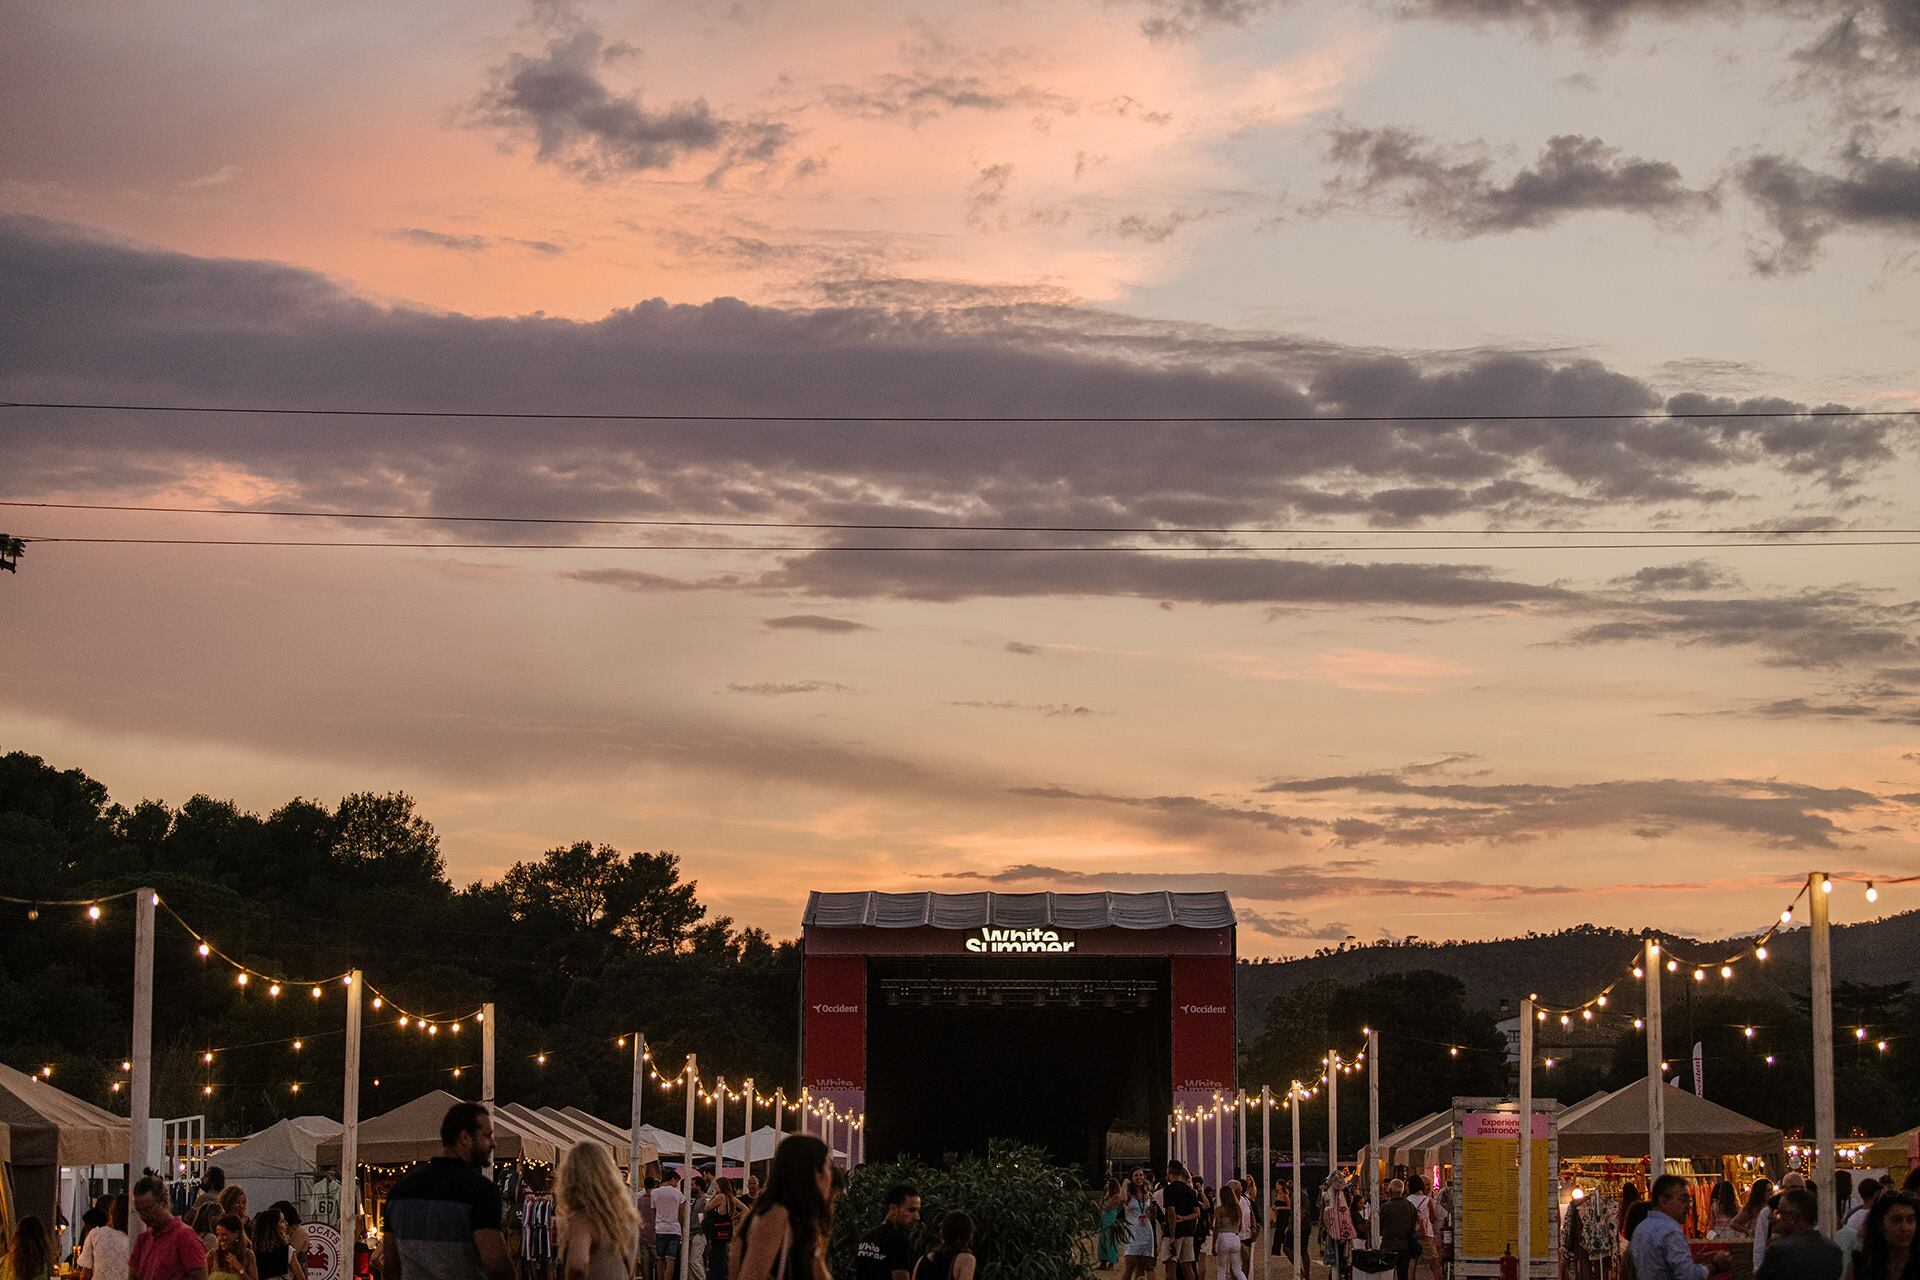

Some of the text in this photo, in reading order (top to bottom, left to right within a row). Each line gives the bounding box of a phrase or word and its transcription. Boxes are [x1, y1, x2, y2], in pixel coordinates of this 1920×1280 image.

[981, 927, 1059, 942] White
[965, 938, 1075, 952] Summer
[822, 1004, 858, 1013] Occident
[1190, 1004, 1226, 1014] Occident
[815, 1078, 854, 1086] White
[1184, 1078, 1223, 1087] White
[808, 1084, 862, 1092] Summer
[1176, 1085, 1230, 1093] Summer
[319, 1201, 334, 1214] 60
[308, 1225, 341, 1245] OCATS
